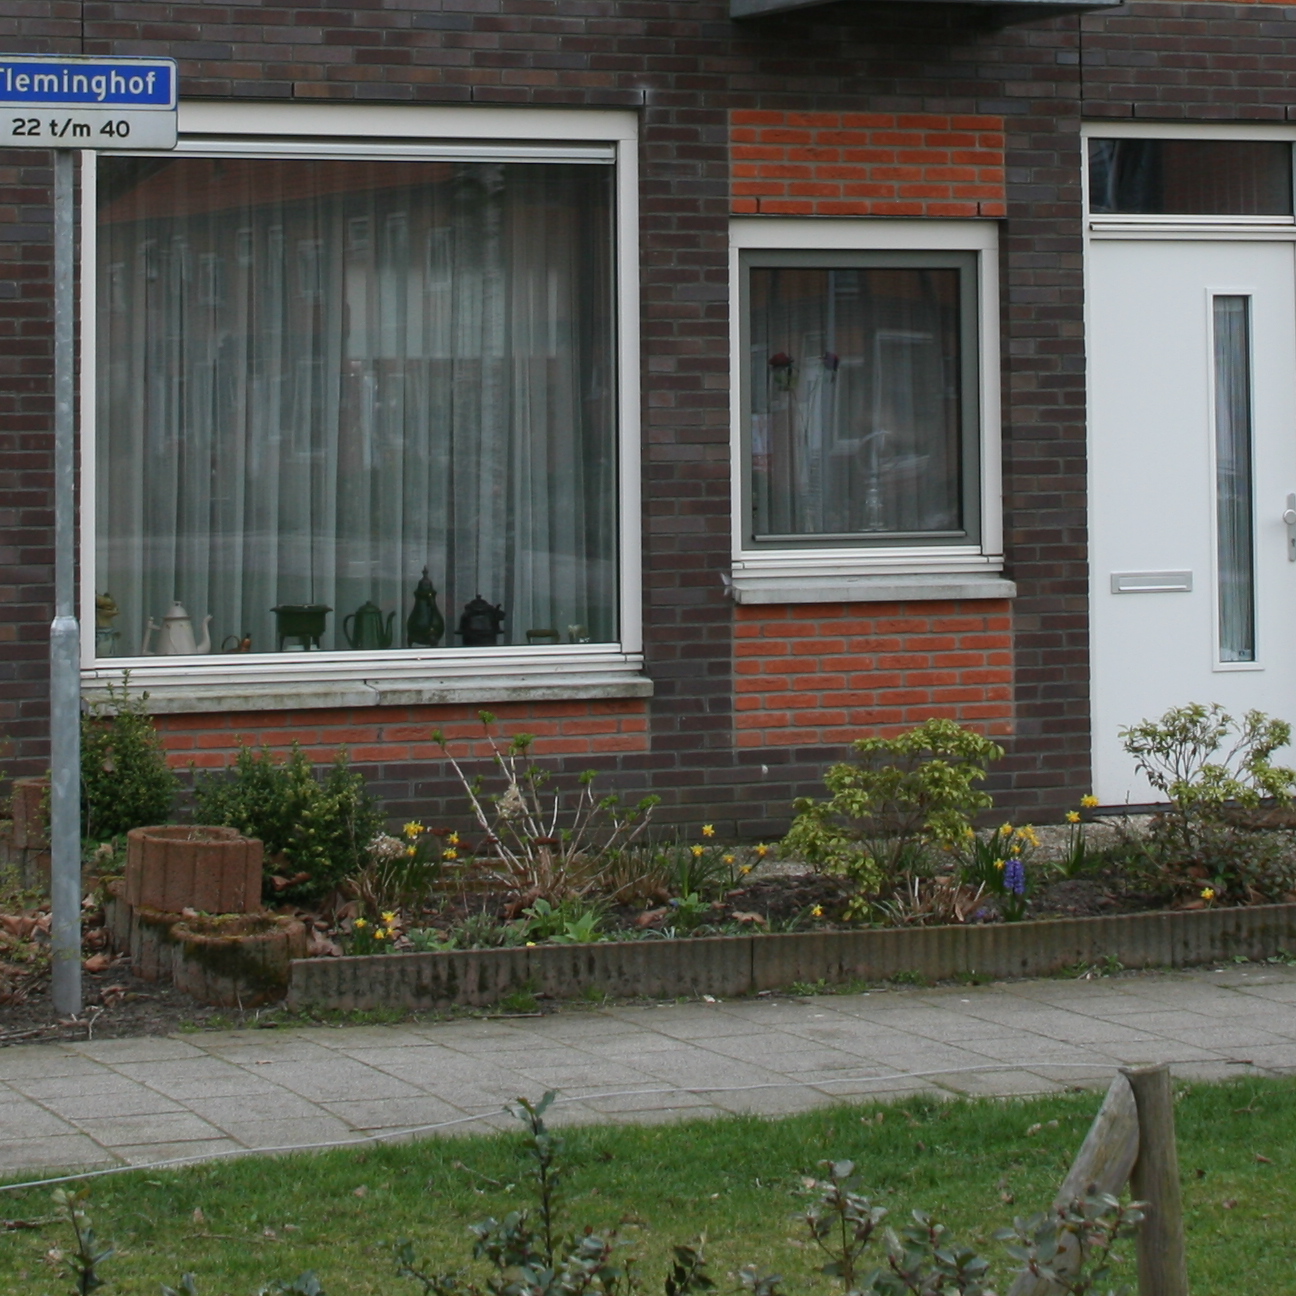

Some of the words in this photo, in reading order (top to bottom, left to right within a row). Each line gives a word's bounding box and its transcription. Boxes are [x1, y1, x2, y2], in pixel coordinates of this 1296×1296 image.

[12, 118, 41, 136] 22
[49, 118, 91, 137] t/m
[99, 120, 130, 138] 40
